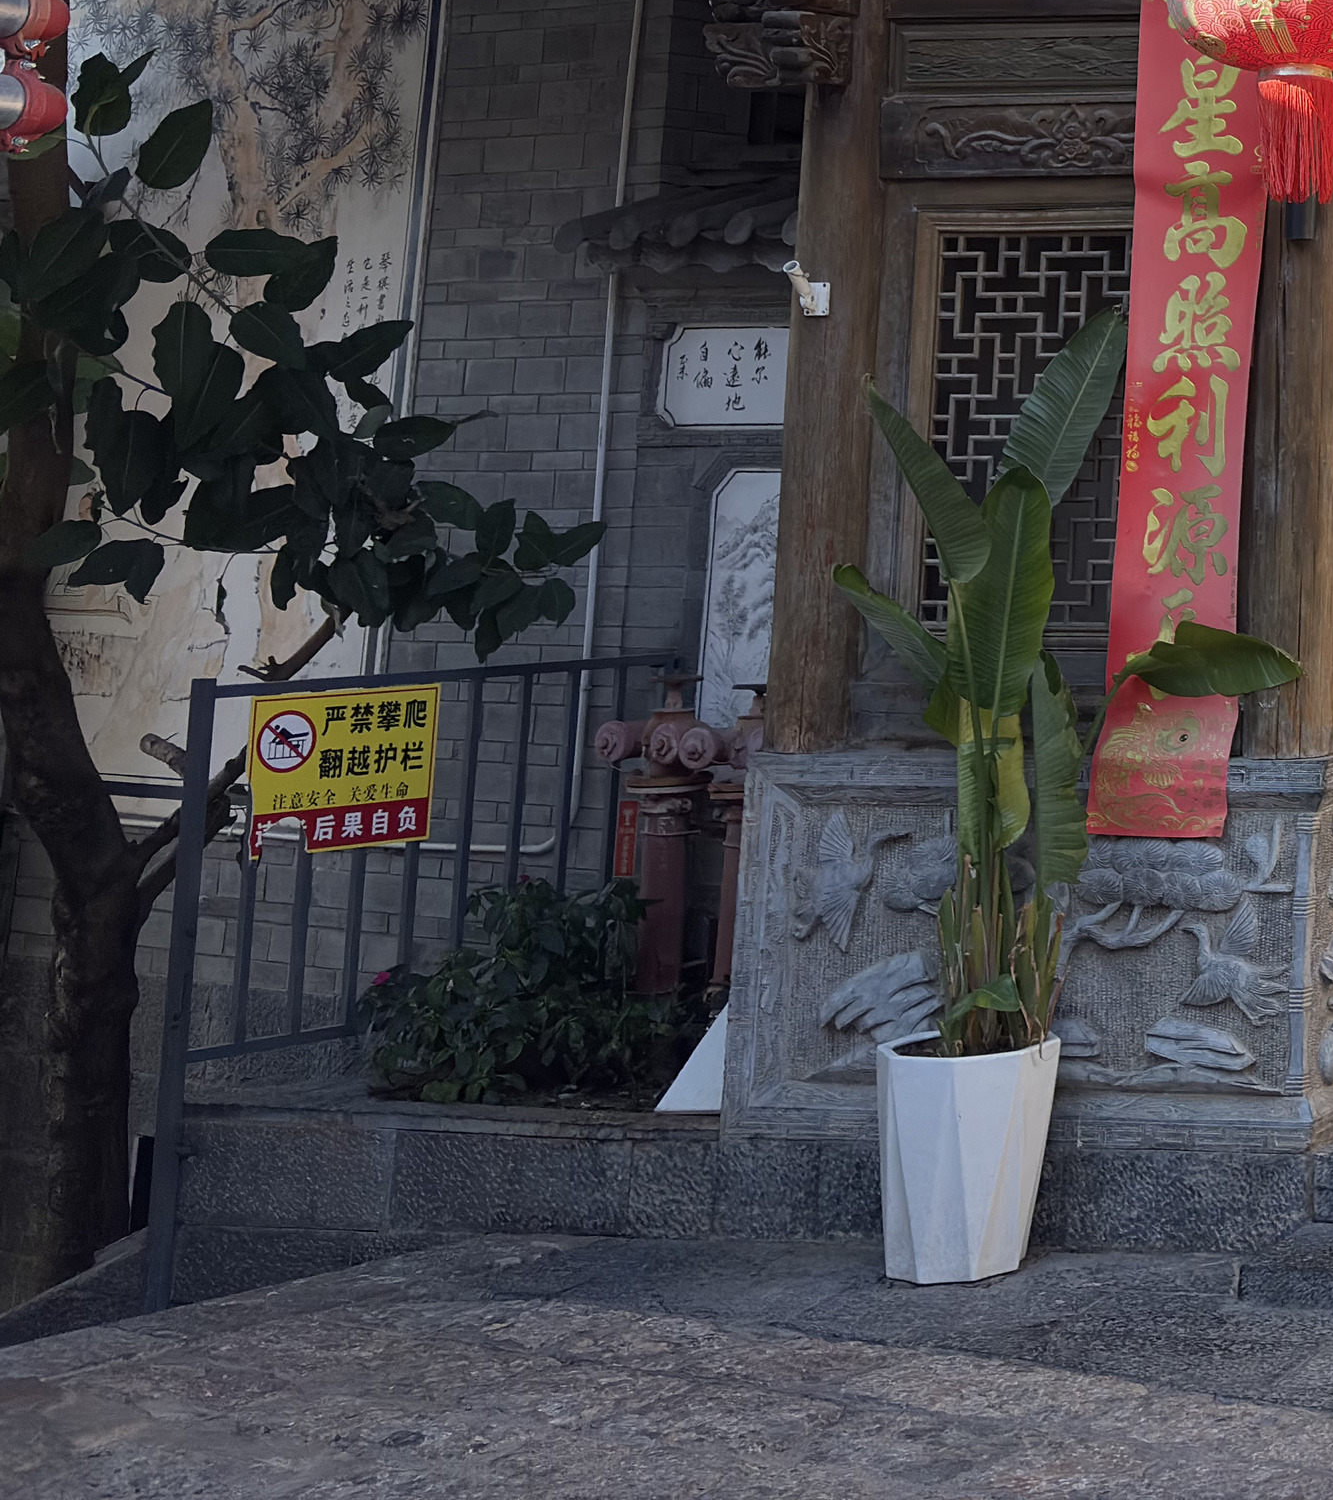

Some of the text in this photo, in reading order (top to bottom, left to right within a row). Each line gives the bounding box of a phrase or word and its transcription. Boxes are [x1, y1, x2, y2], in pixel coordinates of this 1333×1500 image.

[321, 699, 427, 737] 严禁攀爬
[319, 740, 425, 780] 翻越护栏
[272, 781, 410, 811] 注意安全 关爱生命
[255, 805, 417, 848] 后果自负
